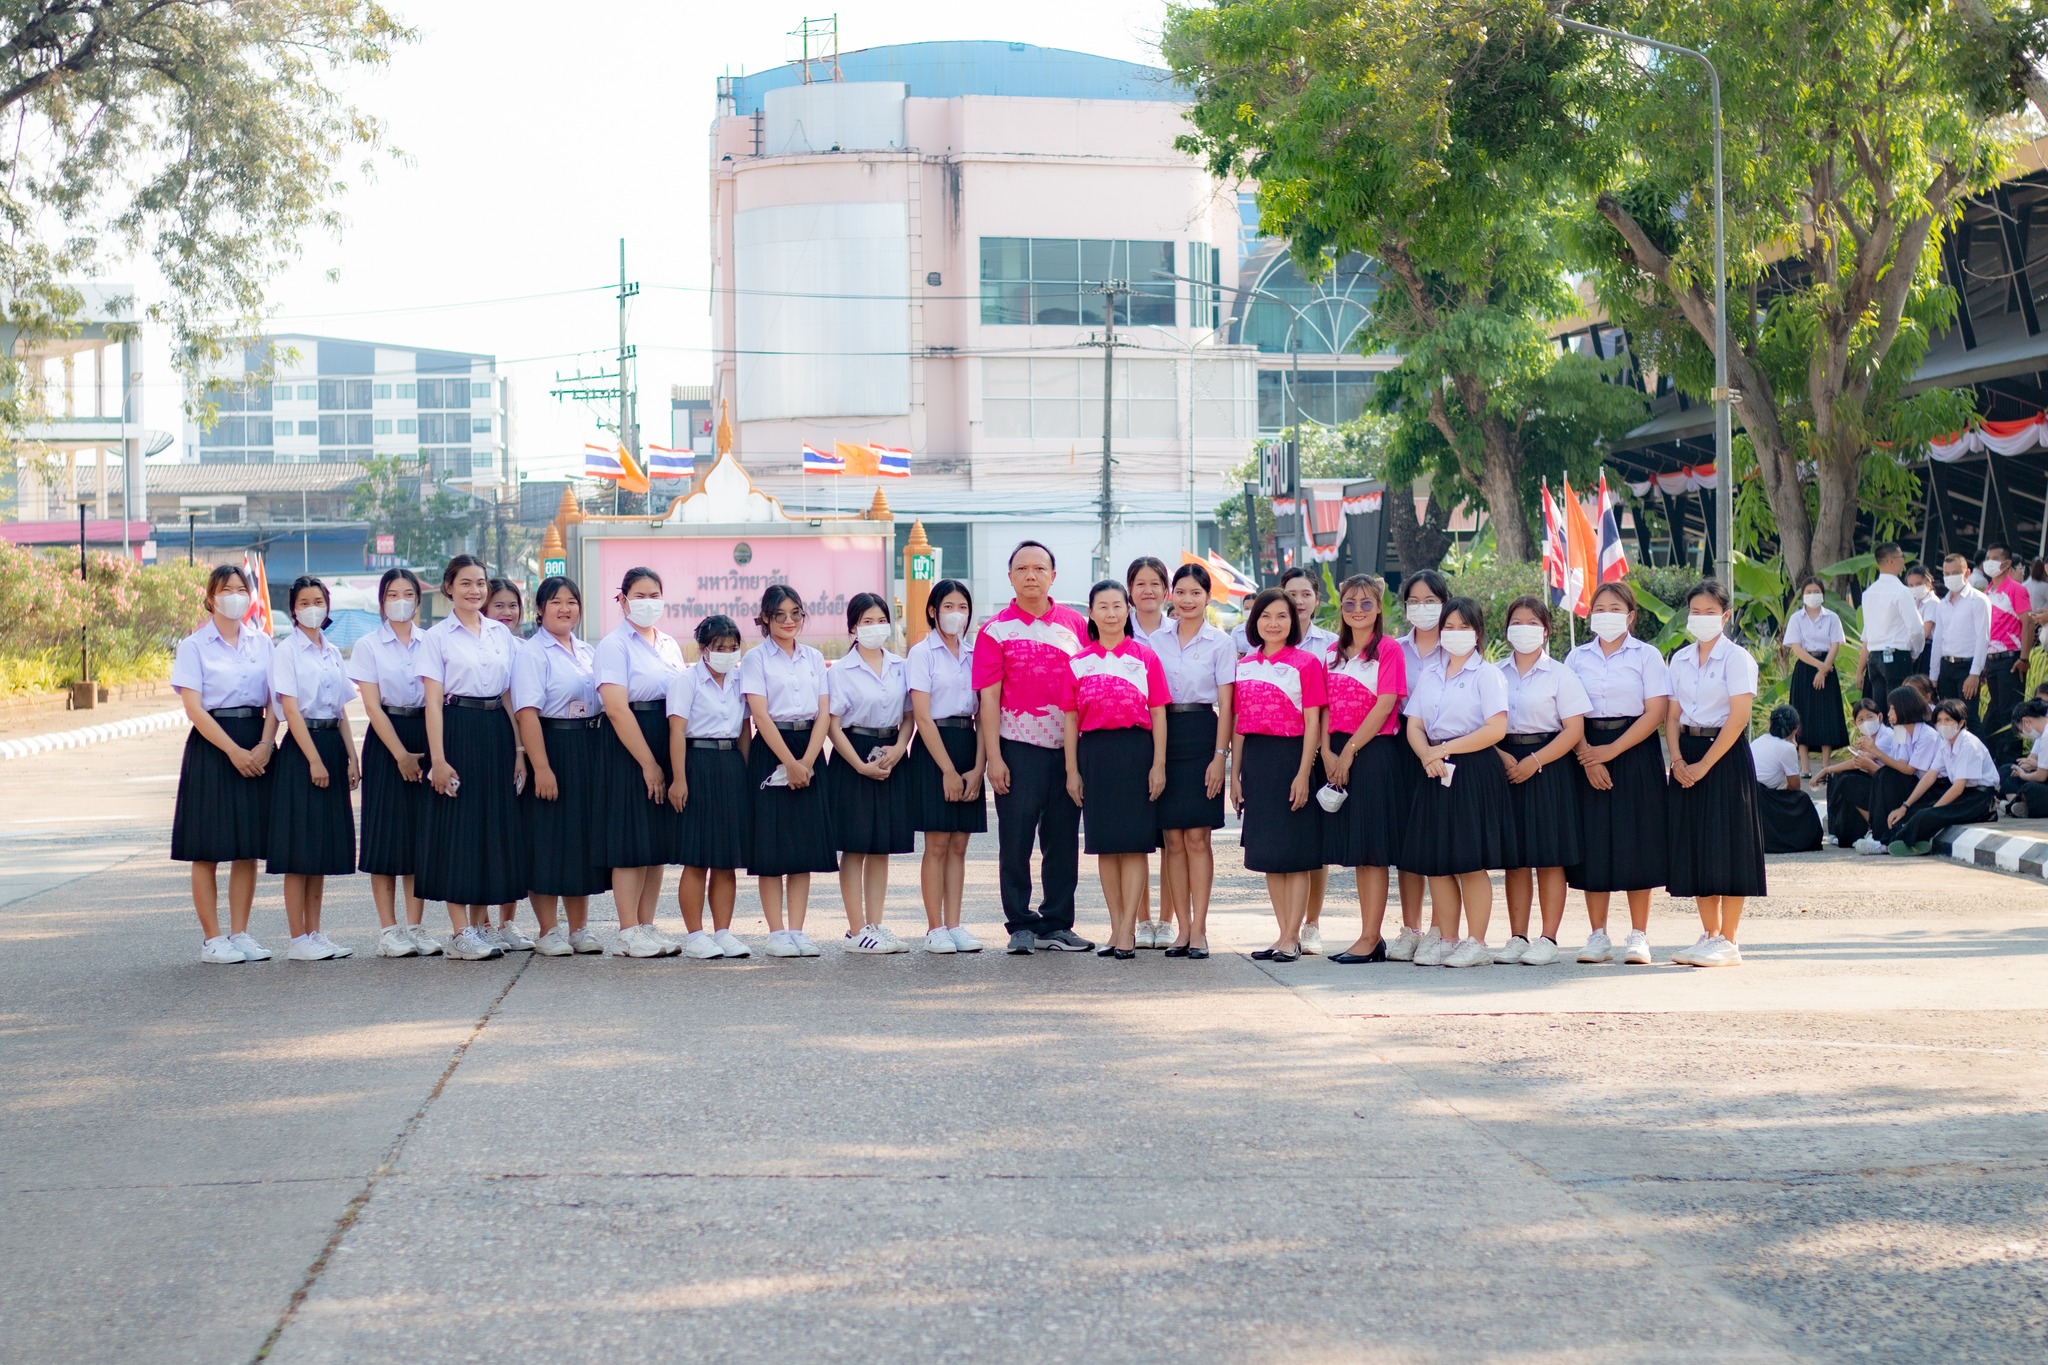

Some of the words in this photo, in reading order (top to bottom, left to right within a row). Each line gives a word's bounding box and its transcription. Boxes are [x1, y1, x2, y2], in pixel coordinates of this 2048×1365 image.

[545, 561, 565, 575] ออก
[697, 568, 789, 590] มหาวิทยาลัย
[915, 571, 929, 580] IN
